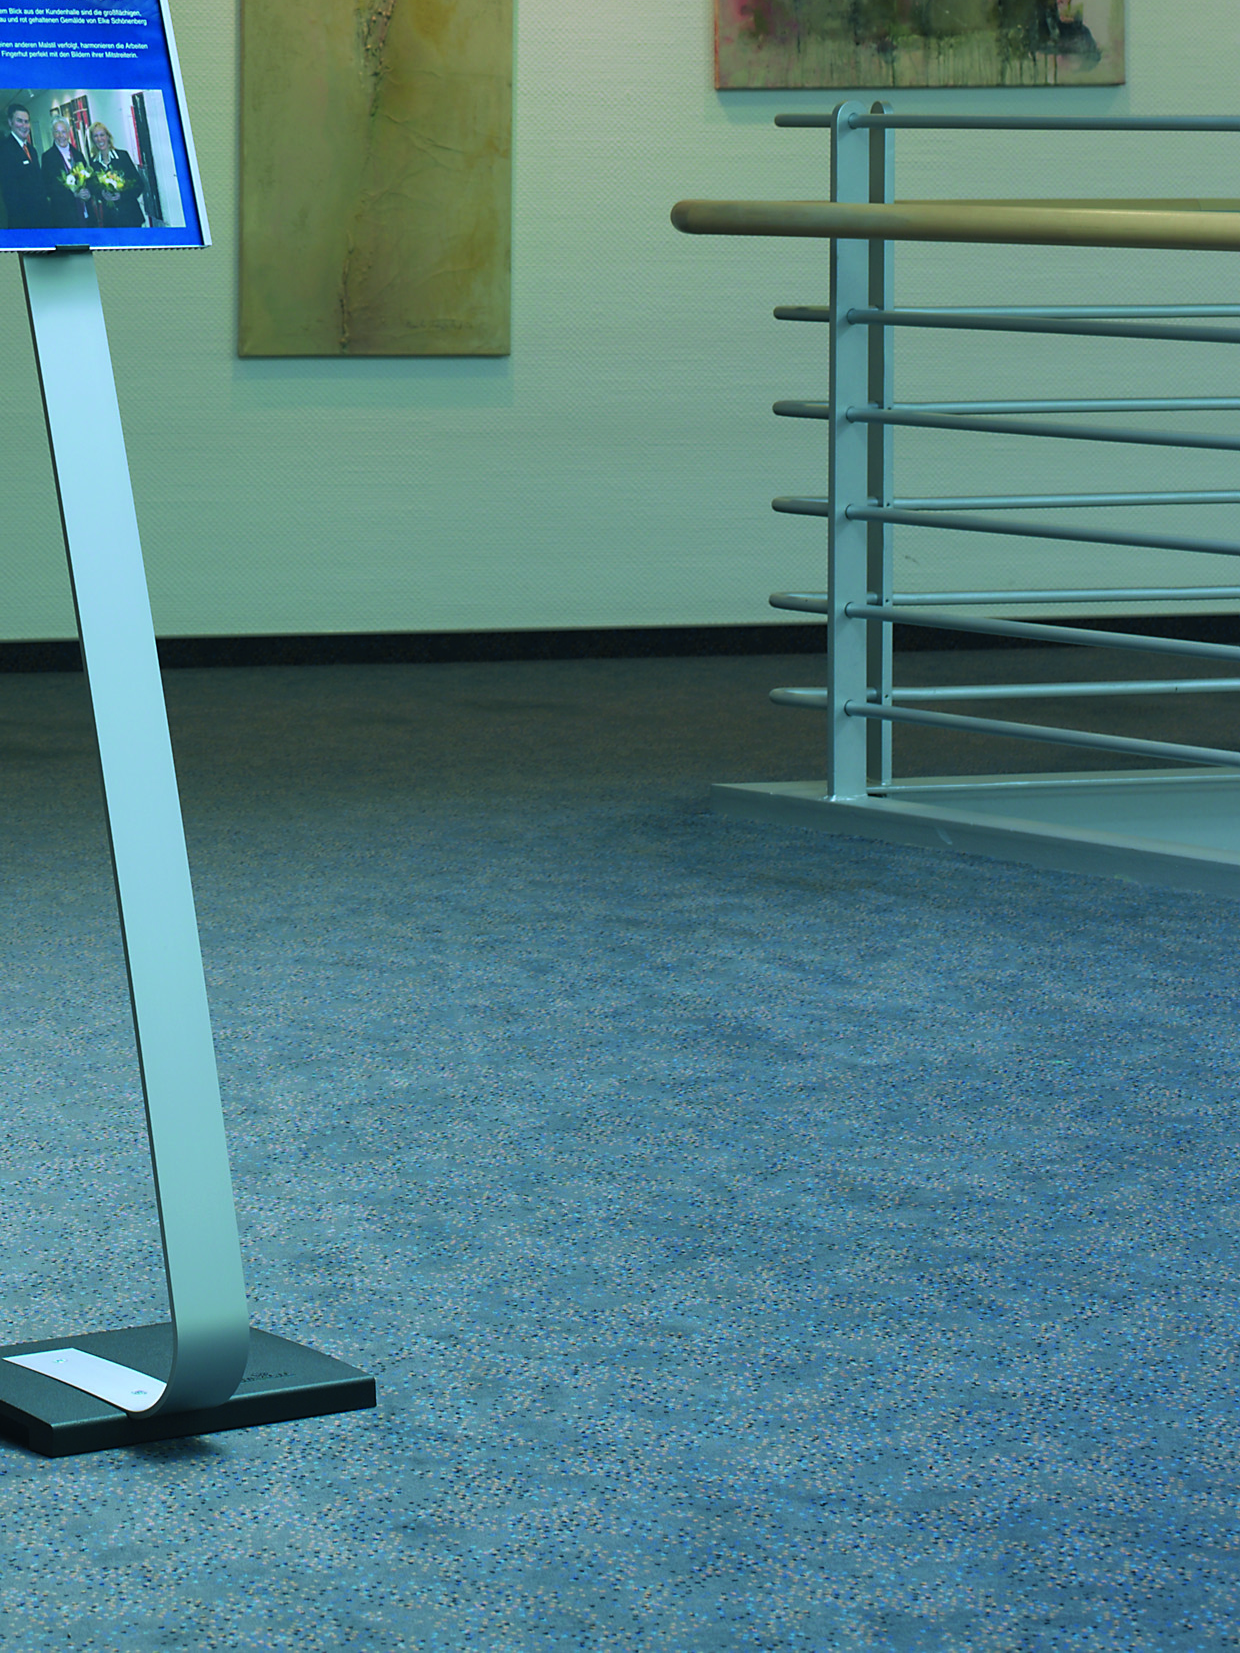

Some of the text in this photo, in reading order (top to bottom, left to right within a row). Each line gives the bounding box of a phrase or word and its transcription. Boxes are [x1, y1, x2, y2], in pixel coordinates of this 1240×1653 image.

[29, 16, 59, 25] gehaltenen
[111, 17, 147, 26] Schönenberg
[2, 50, 27, 59] Fingerhut
[29, 50, 48, 59] perfekt
